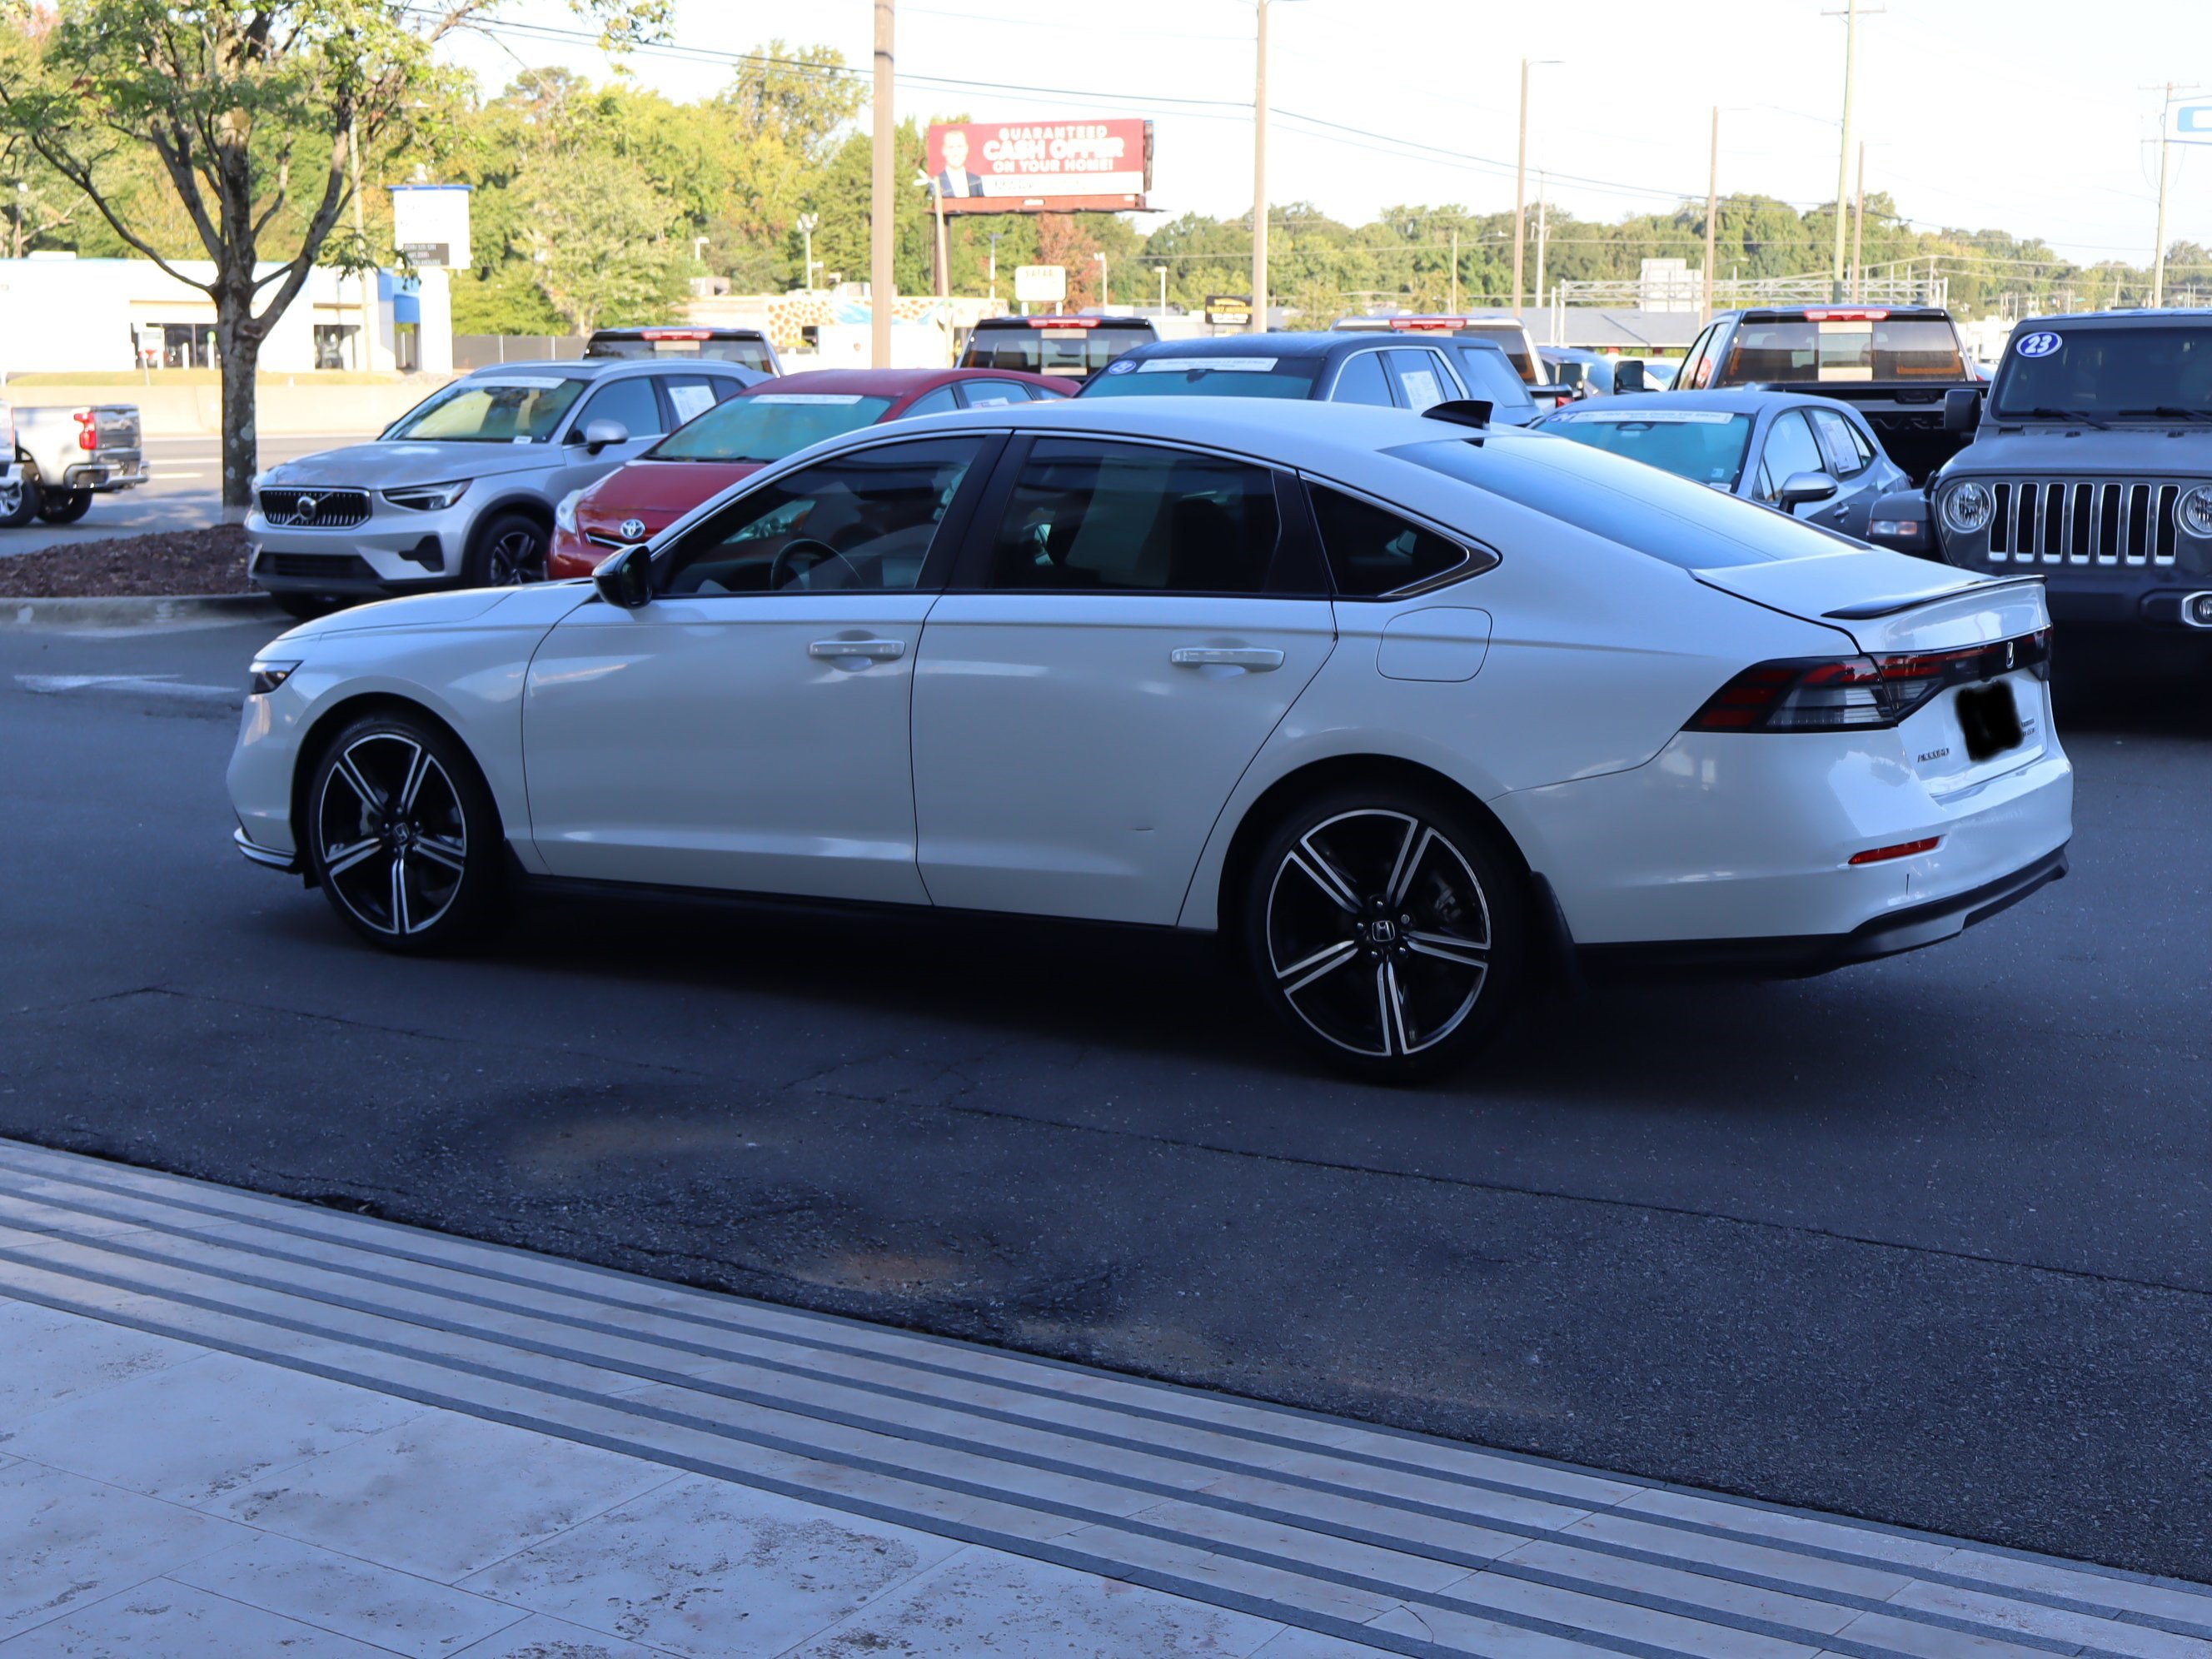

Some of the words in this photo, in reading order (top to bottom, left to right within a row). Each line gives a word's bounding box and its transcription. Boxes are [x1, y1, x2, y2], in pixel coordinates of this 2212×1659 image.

[999, 125, 1108, 140] GUARANTEED
[983, 139, 1045, 161] CASH
[1049, 137, 1125, 160] OFFER
[993, 159, 1015, 173] ON
[1019, 159, 1060, 173] YOUR
[1064, 158, 1113, 172] HOME!
[2024, 335, 2053, 354] 23
